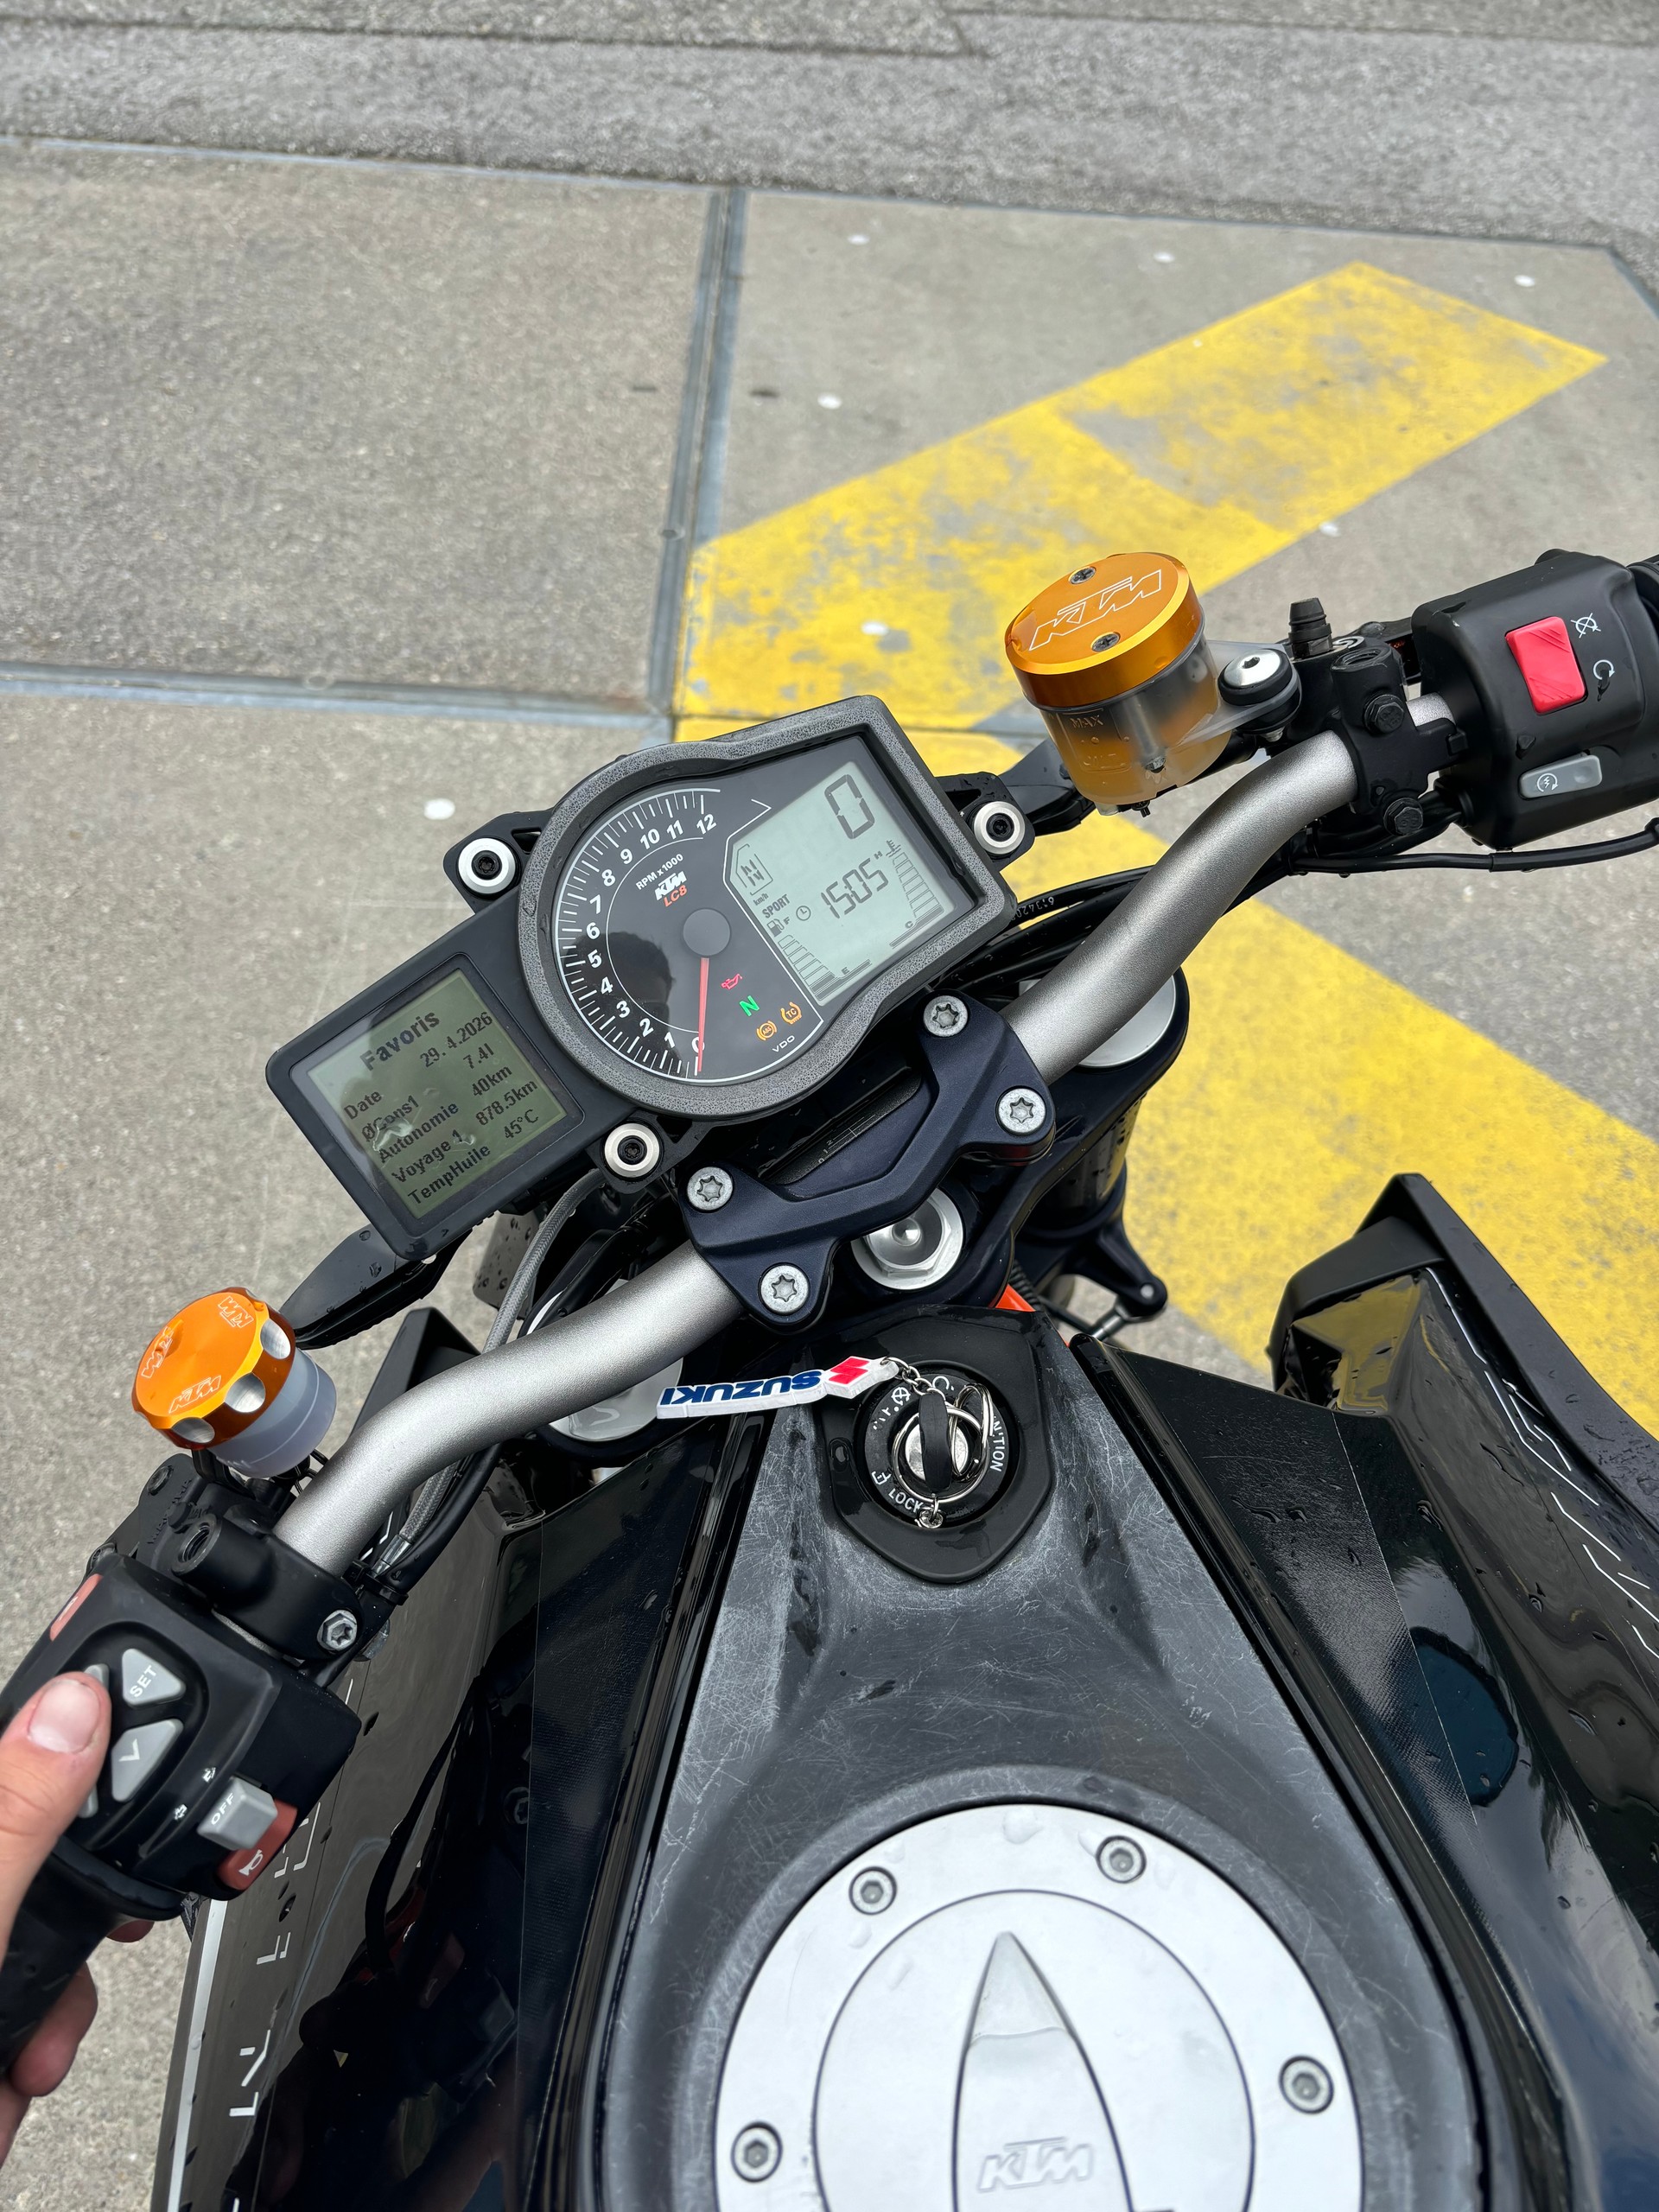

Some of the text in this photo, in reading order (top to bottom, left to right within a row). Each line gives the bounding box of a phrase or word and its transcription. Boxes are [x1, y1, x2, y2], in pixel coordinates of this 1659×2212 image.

[1028, 569, 1162, 652] KTM
[1071, 715, 1103, 728] MAX
[824, 774, 875, 839] 0
[666, 819, 683, 840] 11
[696, 813, 717, 835] 12
[639, 828, 660, 849] 10
[620, 848, 633, 865] 9
[601, 868, 616, 887] 8
[635, 871, 658, 890] RPM
[654, 870, 687, 901] KTM
[589, 893, 601, 914] 7
[664, 884, 687, 907] LC8
[753, 893, 769, 906] km/h
[761, 893, 791, 918] SPORT
[586, 922, 601, 939] 6
[783, 916, 791, 925] F
[588, 949, 602, 968] 5
[601, 976, 613, 995] 4
[616, 1000, 631, 1019] 3
[739, 995, 760, 1017] N
[639, 1018, 654, 1037] 2
[359, 1011, 441, 1071] Favoris
[664, 1032, 676, 1048] 1
[772, 1035, 796, 1052] VDO
[343, 1090, 383, 1120] Date
[378, 1065, 512, 1163] Autonomie 40km
[391, 1079, 538, 1184] Voyage 1 878.5km
[407, 1109, 539, 1205] TempHuile 45°C
[217, 1295, 254, 1328] KTM
[168, 1375, 221, 1414] KTM
[659, 1370, 822, 1406] SUZUKI
[888, 1488, 924, 1514] LOCK
[130, 1664, 158, 1698] SET
[210, 1792, 235, 1825] OFF
[976, 2135, 1095, 2193] KTM
